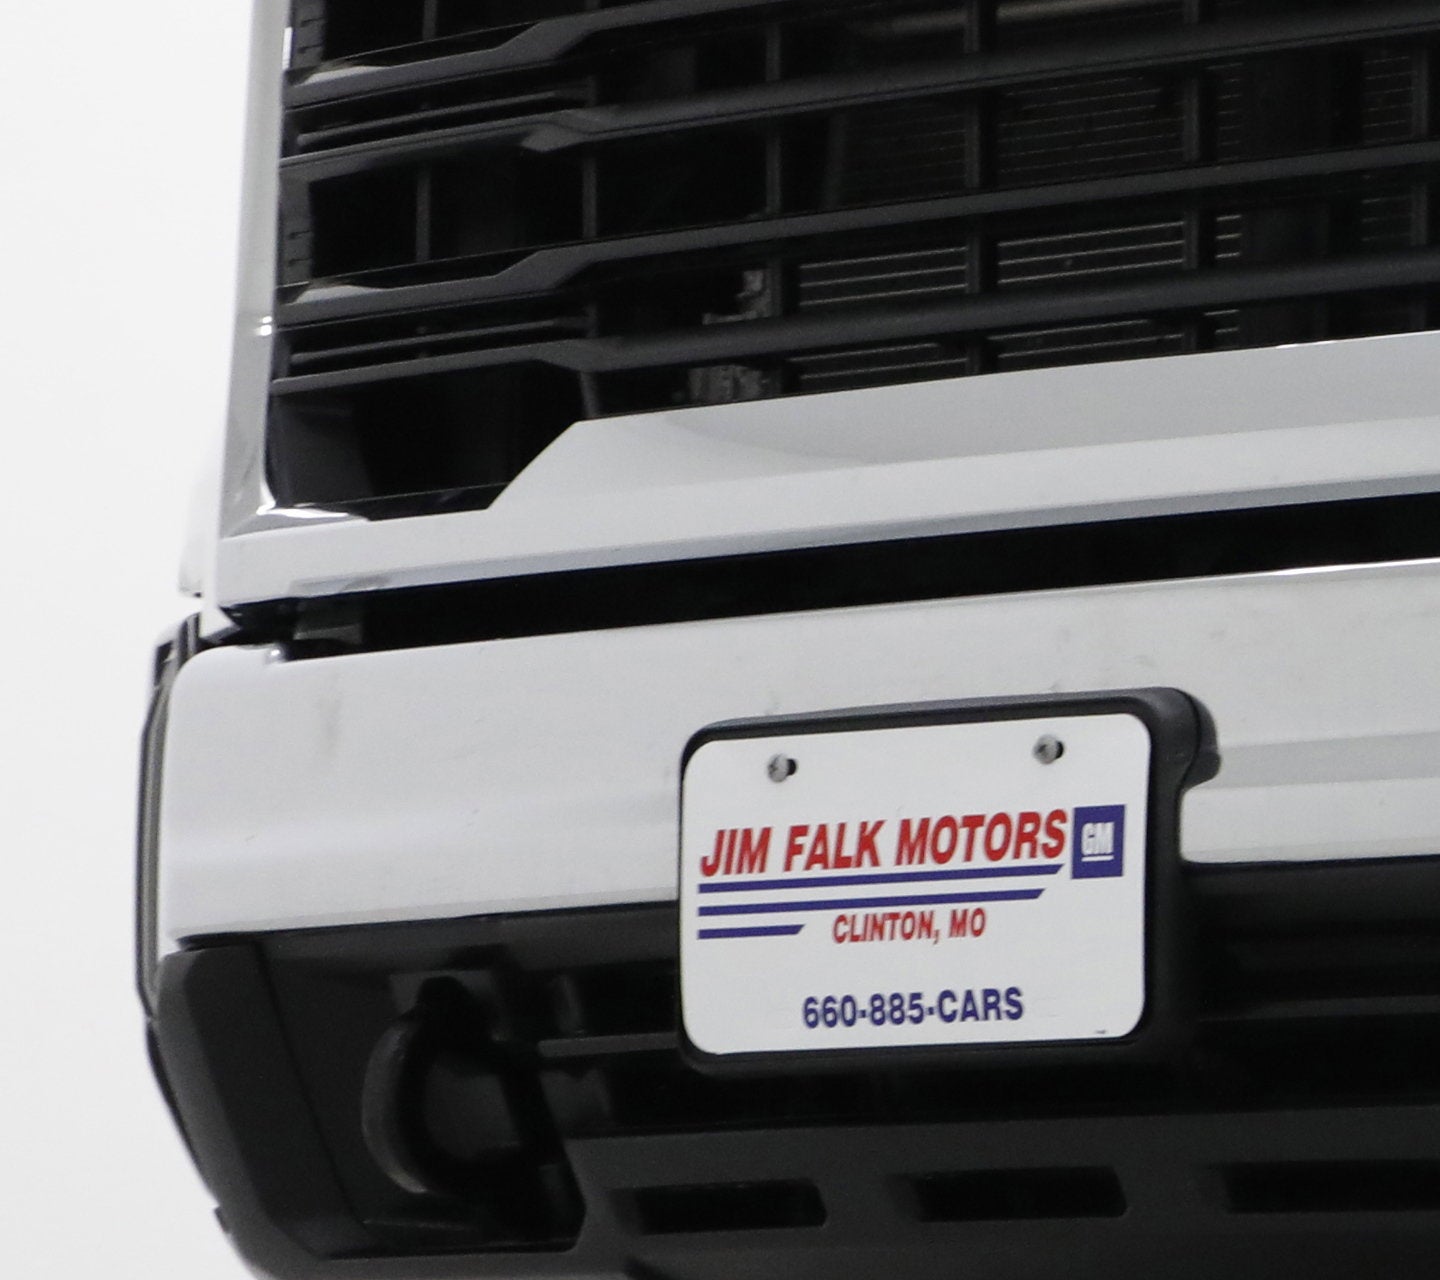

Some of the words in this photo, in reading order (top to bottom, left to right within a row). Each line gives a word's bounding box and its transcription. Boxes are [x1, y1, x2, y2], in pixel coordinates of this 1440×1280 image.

[700, 826, 771, 877] JIM
[783, 819, 886, 872] FALK
[894, 808, 1069, 866] MOTORS
[1081, 820, 1115, 856] GM
[832, 909, 940, 946] CLINTON,
[950, 907, 987, 938] MO
[803, 986, 1024, 1030] 660-885-CARS
